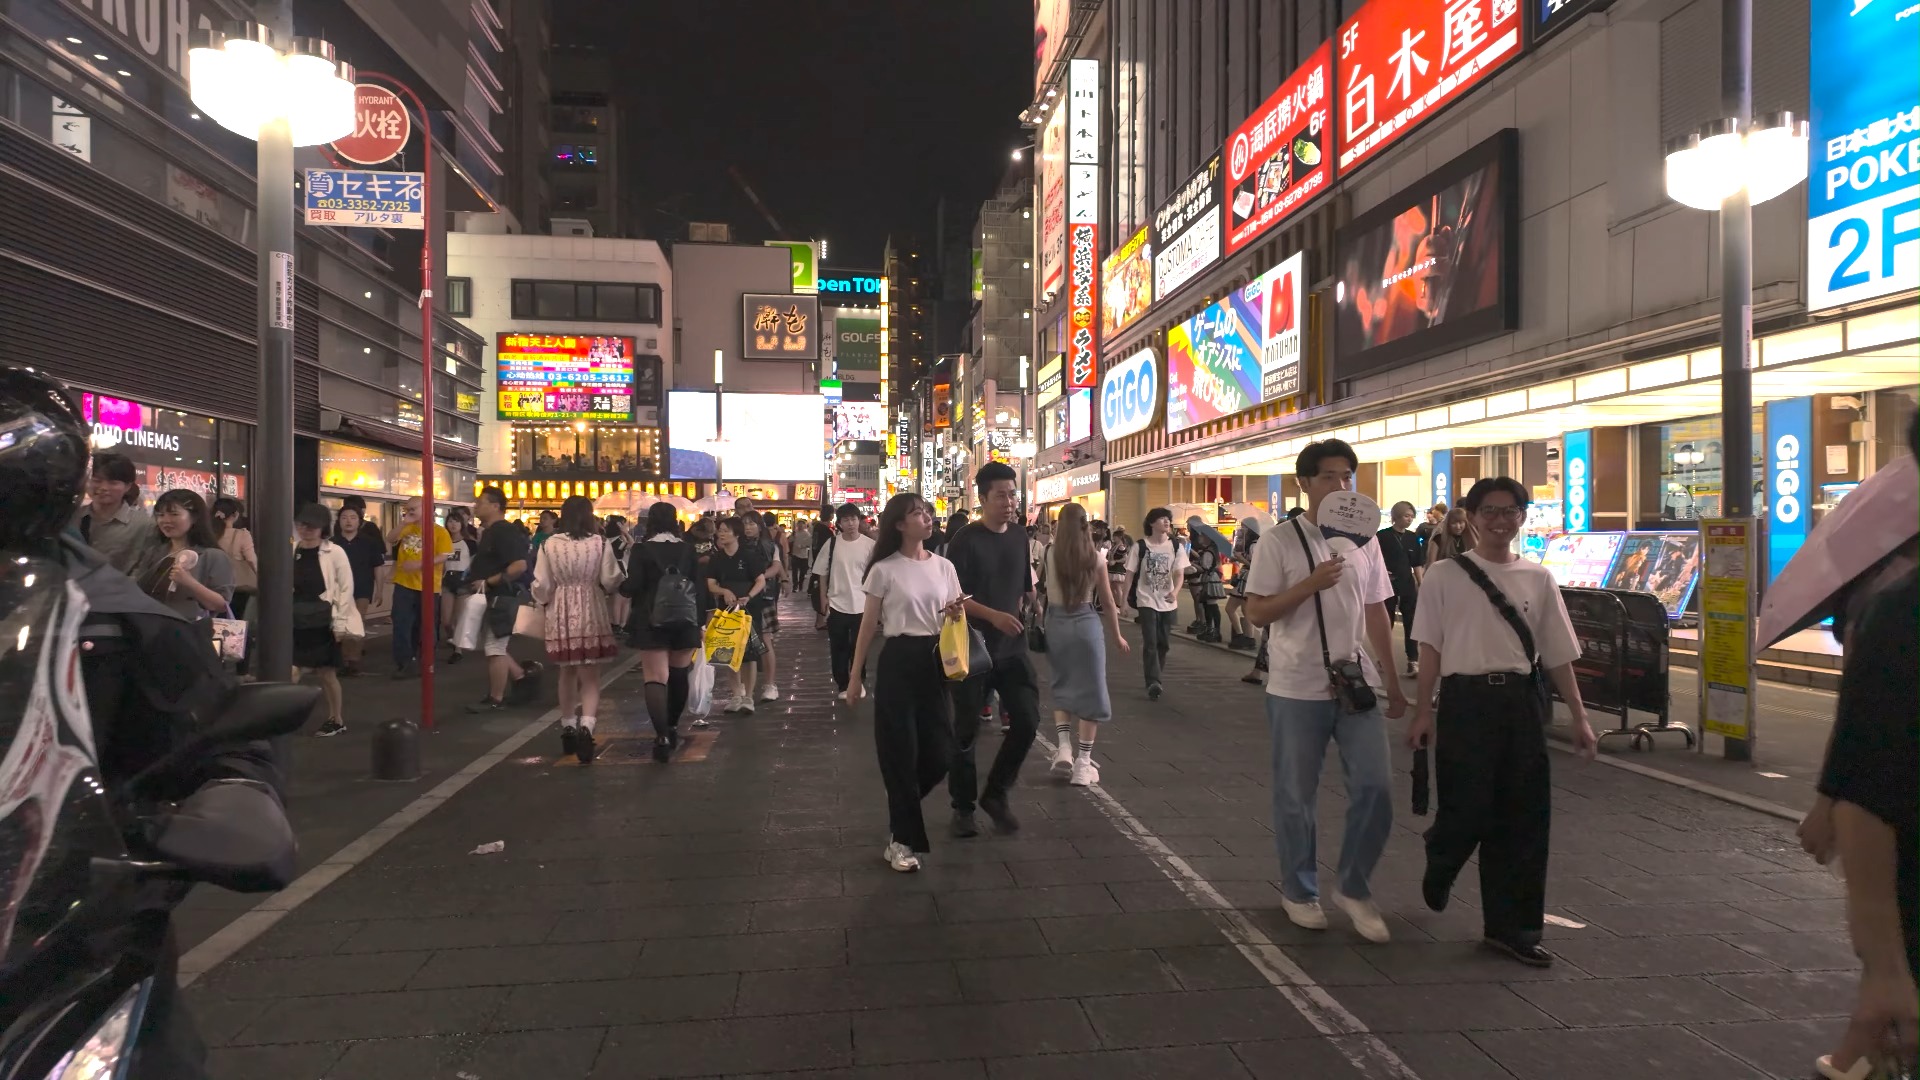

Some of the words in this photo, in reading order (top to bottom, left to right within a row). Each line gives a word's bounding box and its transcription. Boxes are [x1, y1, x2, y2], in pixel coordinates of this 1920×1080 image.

[1342, 22, 1359, 59] 5F
[1346, 0, 1488, 143] 白木屋
[358, 96, 393, 105] HYDRANT
[1310, 109, 1326, 136] 6F
[1209, 156, 1219, 181] 7F
[310, 210, 336, 221] 買取
[354, 212, 403, 223] アルタ裏
[328, 199, 410, 211] 03-3352-7325
[1827, 196, 1920, 293] 2F
[1073, 227, 1092, 306] 横浜家系
[841, 332, 880, 343] GOLF5
[1194, 308, 1238, 343] ゲームの
[1074, 330, 1092, 384] ラーメン
[1197, 340, 1243, 371] オアシスに
[547, 372, 630, 382] 03-6205-5612
[1103, 359, 1154, 430] GiGO
[92, 422, 122, 446] OHO
[124, 429, 180, 452] CINEMAS
[944, 457, 953, 484] ちから
[1776, 434, 1799, 524] GiGO
